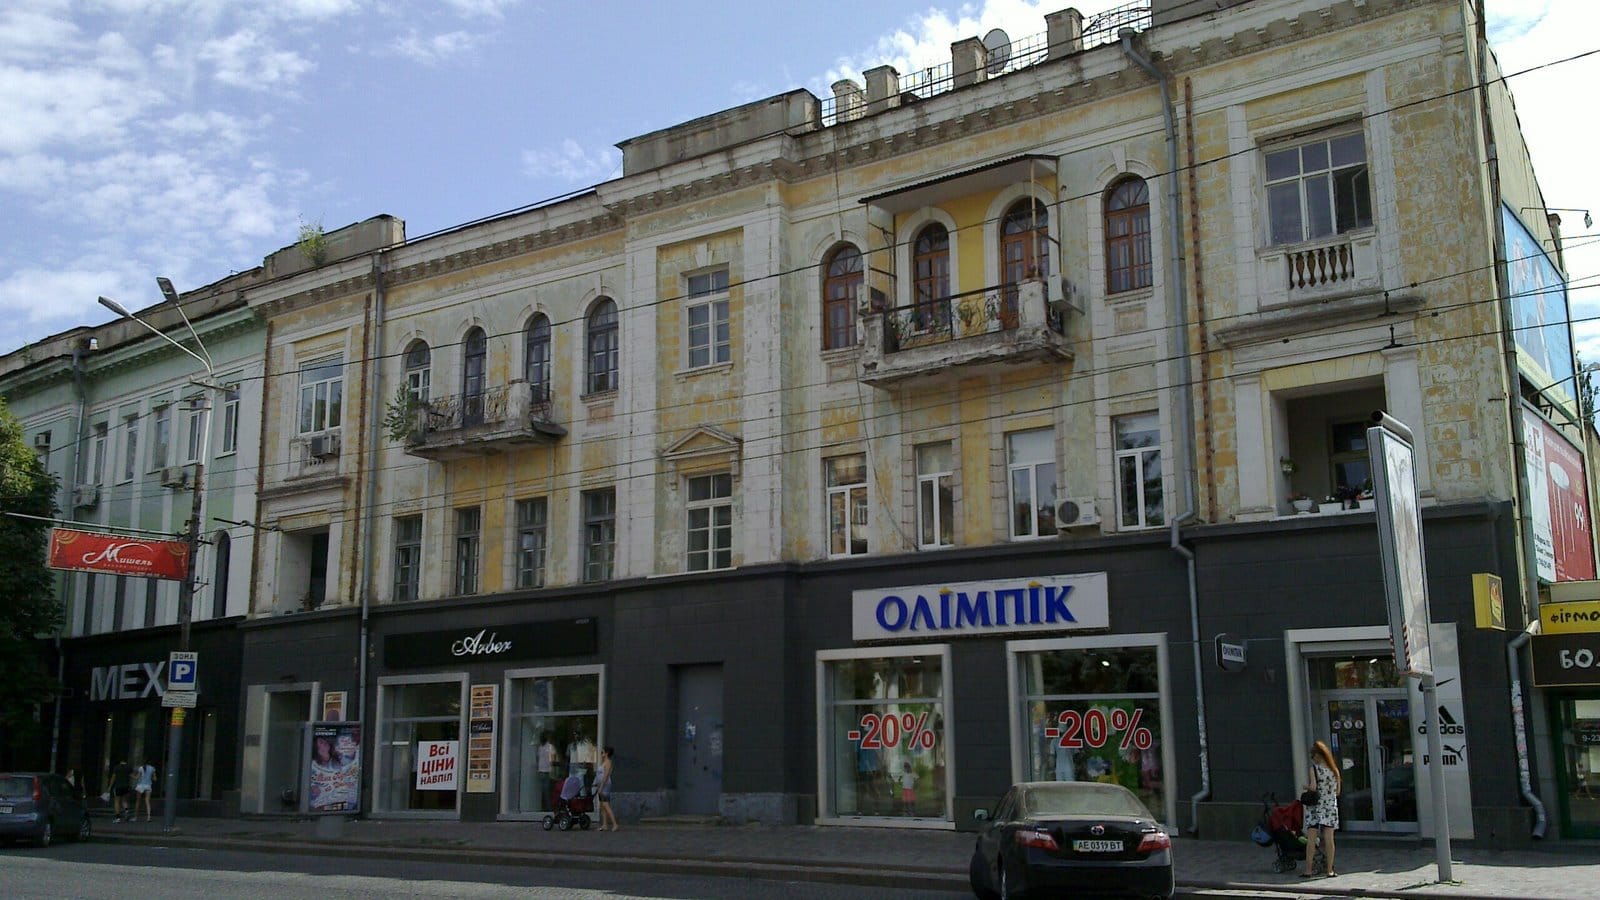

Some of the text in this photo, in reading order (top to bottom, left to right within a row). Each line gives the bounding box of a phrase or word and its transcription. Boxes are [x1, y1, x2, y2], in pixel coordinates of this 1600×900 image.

[82, 542, 154, 565] Мишель
[876, 580, 1078, 632] ОЛІМПІК
[1559, 648, 1600, 669] БО
[175, 663, 192, 681] P
[848, 712, 936, 750] -20%
[1044, 708, 1153, 750] -20%
[1417, 723, 1465, 735] adas
[429, 742, 450, 757] Всі
[421, 756, 455, 776] ЦІНИ
[1423, 754, 1458, 766] PMA
[1078, 841, 1090, 850] AE
[1109, 841, 1122, 850] BT
